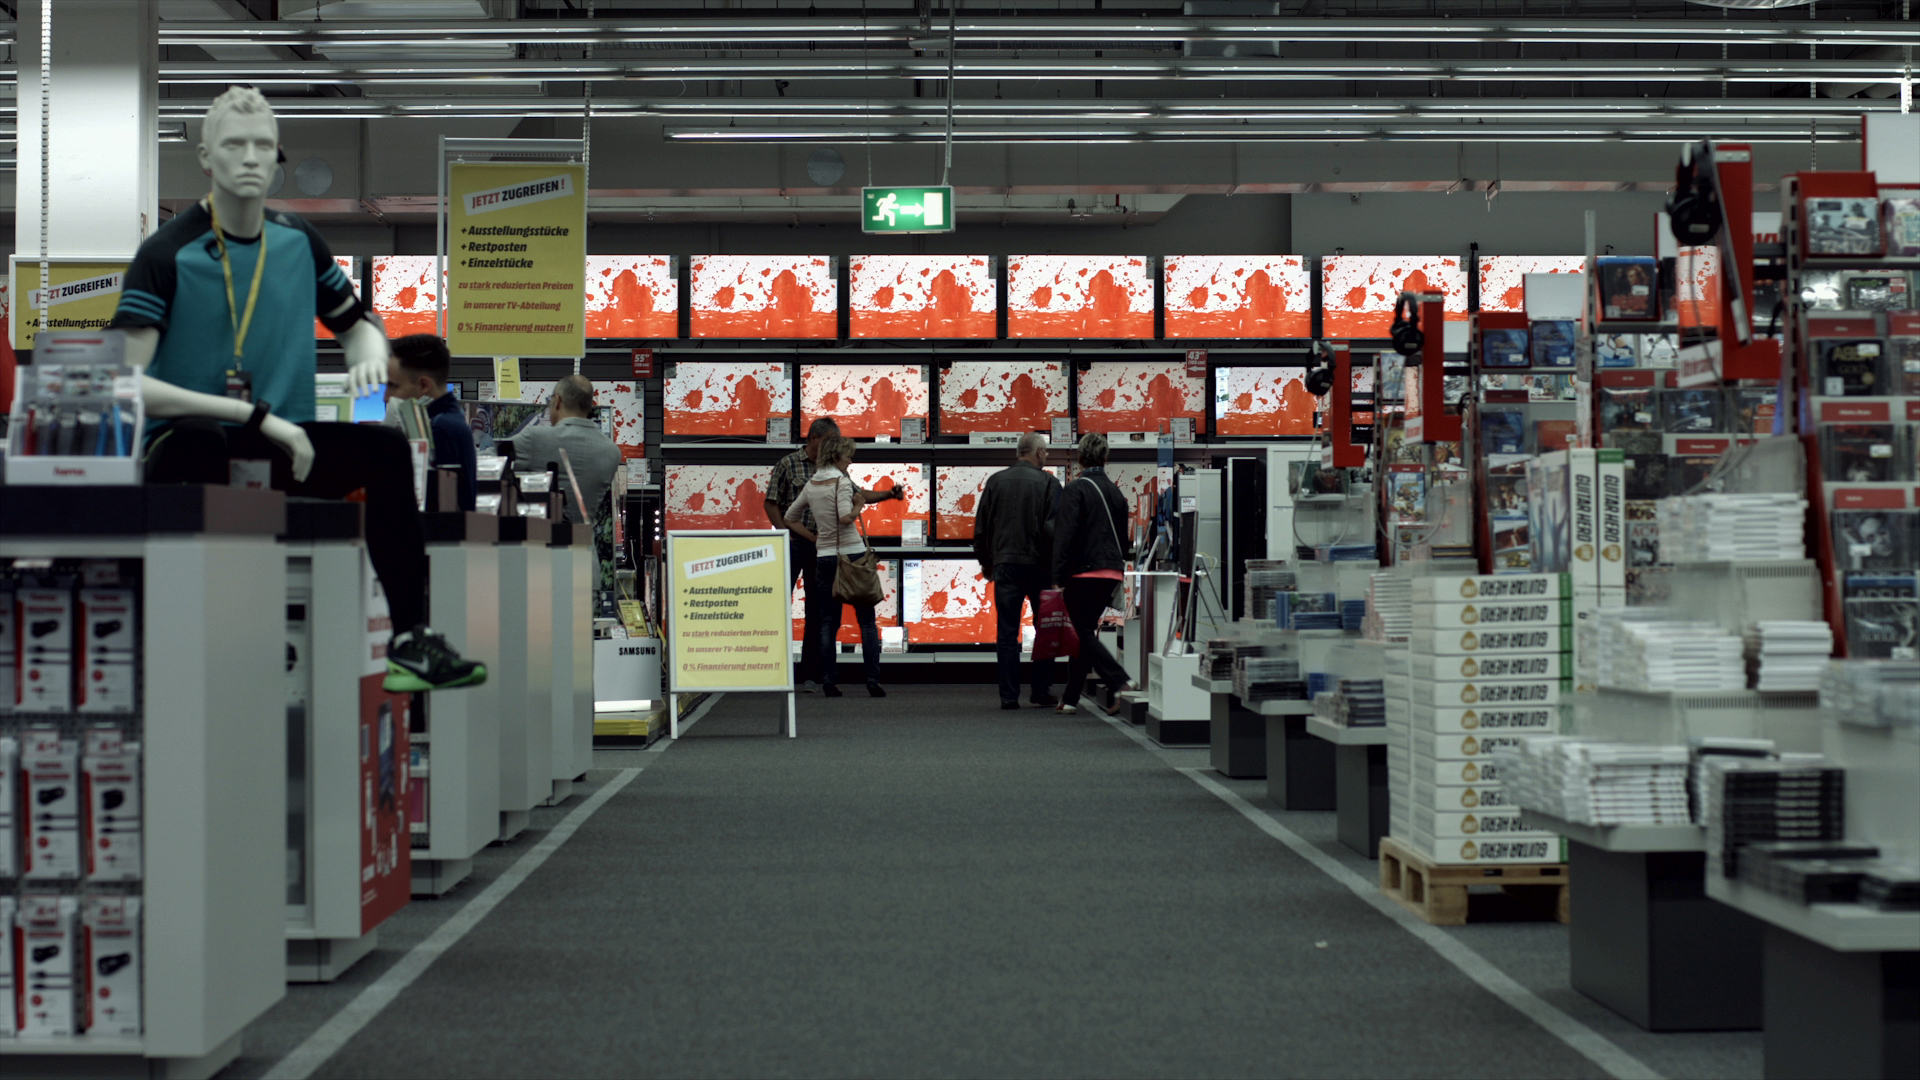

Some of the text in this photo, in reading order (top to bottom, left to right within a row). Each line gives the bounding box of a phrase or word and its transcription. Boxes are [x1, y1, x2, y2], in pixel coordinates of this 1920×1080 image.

[472, 192, 500, 209] JETZT
[502, 180, 559, 202] ZUGREIFEN
[468, 226, 569, 238] Ausstellungsstücke
[468, 242, 527, 253] Restposten
[468, 258, 534, 269] Einzelstücke
[35, 288, 60, 304] JZT
[62, 277, 112, 297] ZUGREIFEN
[458, 281, 574, 290] zu stark reduzierten Preisen
[464, 301, 562, 312] in unserer TV-Abteilung
[465, 322, 473, 332] %
[474, 322, 533, 334] Finanzierung
[534, 324, 566, 332] nutzen
[1832, 346, 1875, 361] ABB
[1575, 474, 1592, 513] GUITAR
[1604, 474, 1620, 513] GUITAR
[1576, 513, 1592, 543] HERO
[1604, 514, 1620, 544] HERO
[691, 560, 714, 574] JETZT
[716, 550, 763, 568] ZUGREIFEN
[689, 586, 773, 596] Ausstellungsstücke
[690, 600, 739, 609] Restposten
[690, 612, 744, 620] Einzelstücke
[692, 630, 710, 638] stark
[710, 629, 751, 637] reduzierten
[752, 629, 778, 637] Preisen
[619, 647, 656, 656] SAMSUNG
[723, 645, 769, 653] TV-Abteilung
[696, 663, 746, 671] Finanzierung
